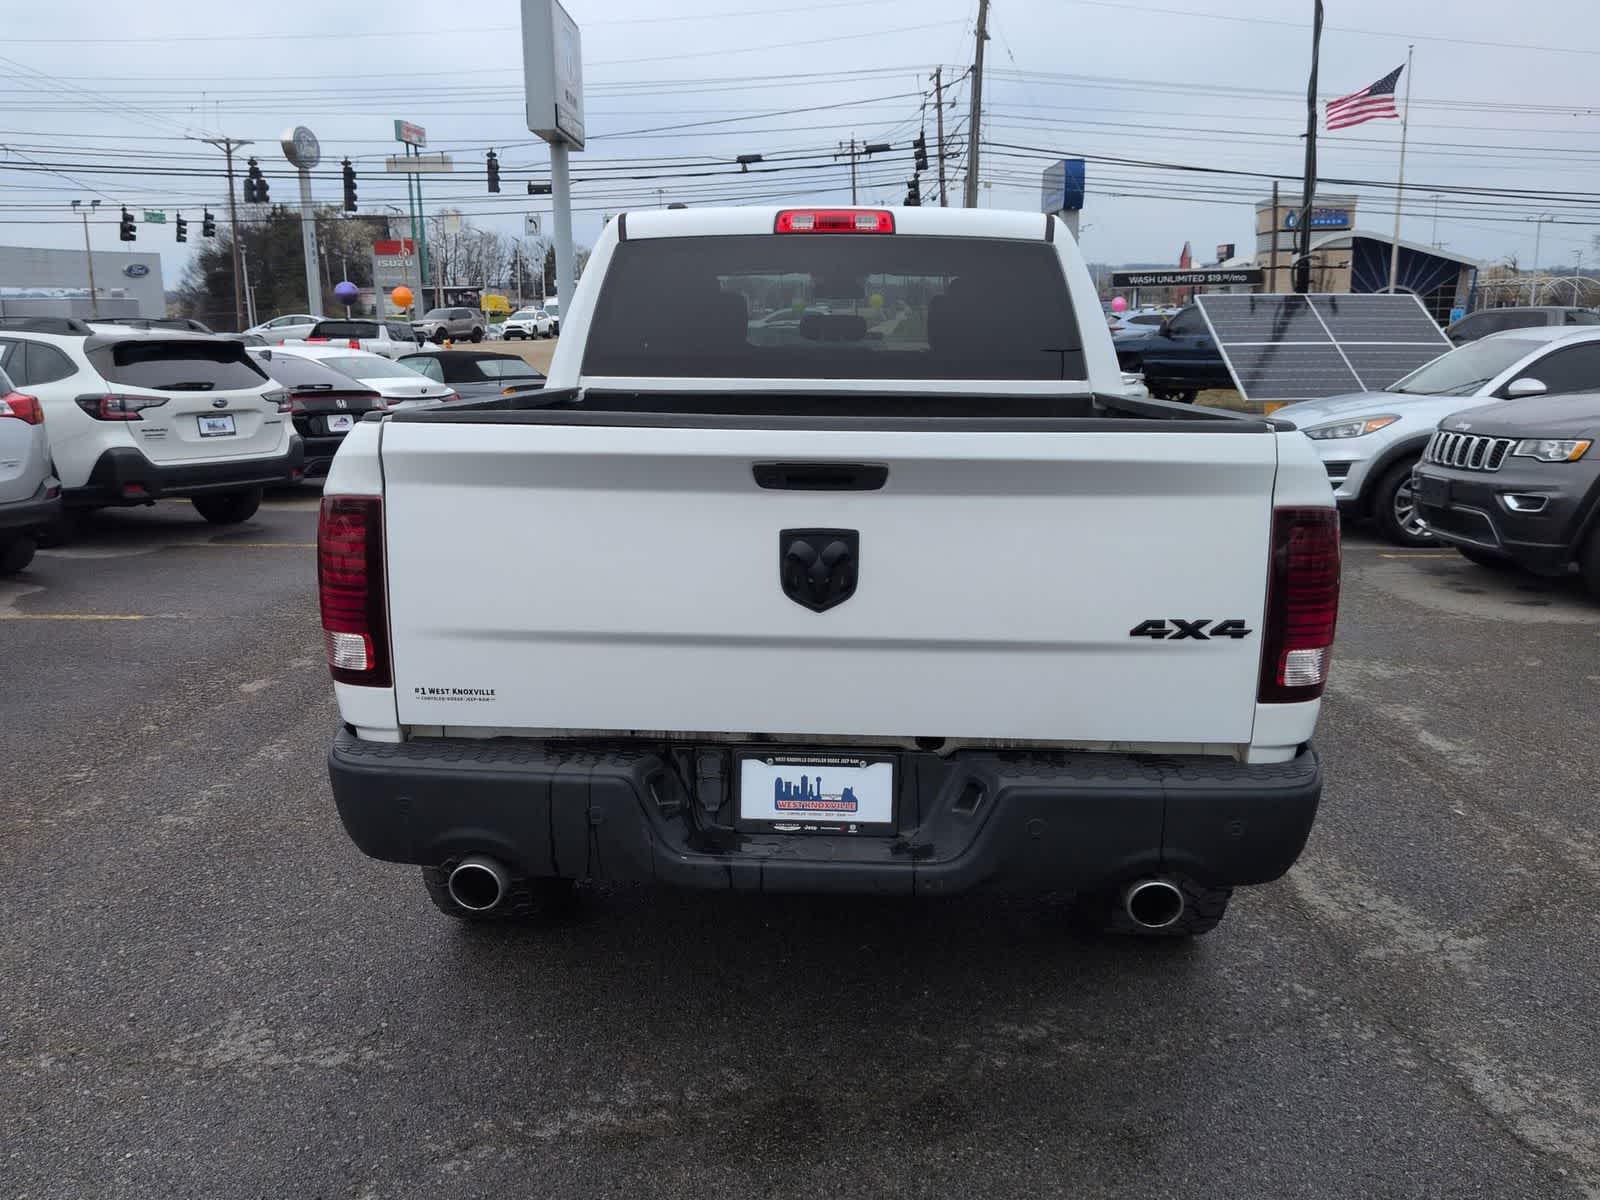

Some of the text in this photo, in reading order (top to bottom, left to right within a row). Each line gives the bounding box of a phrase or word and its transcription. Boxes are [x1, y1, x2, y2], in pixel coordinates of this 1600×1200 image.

[378, 259, 413, 267] ISUZU
[1128, 276, 1155, 285] WASH
[1157, 274, 1205, 284] UNLIMITED
[428, 687, 450, 695] WEST
[452, 687, 496, 696] KNOXVILLE
[777, 800, 857, 811] WEST KNOXVILLE
